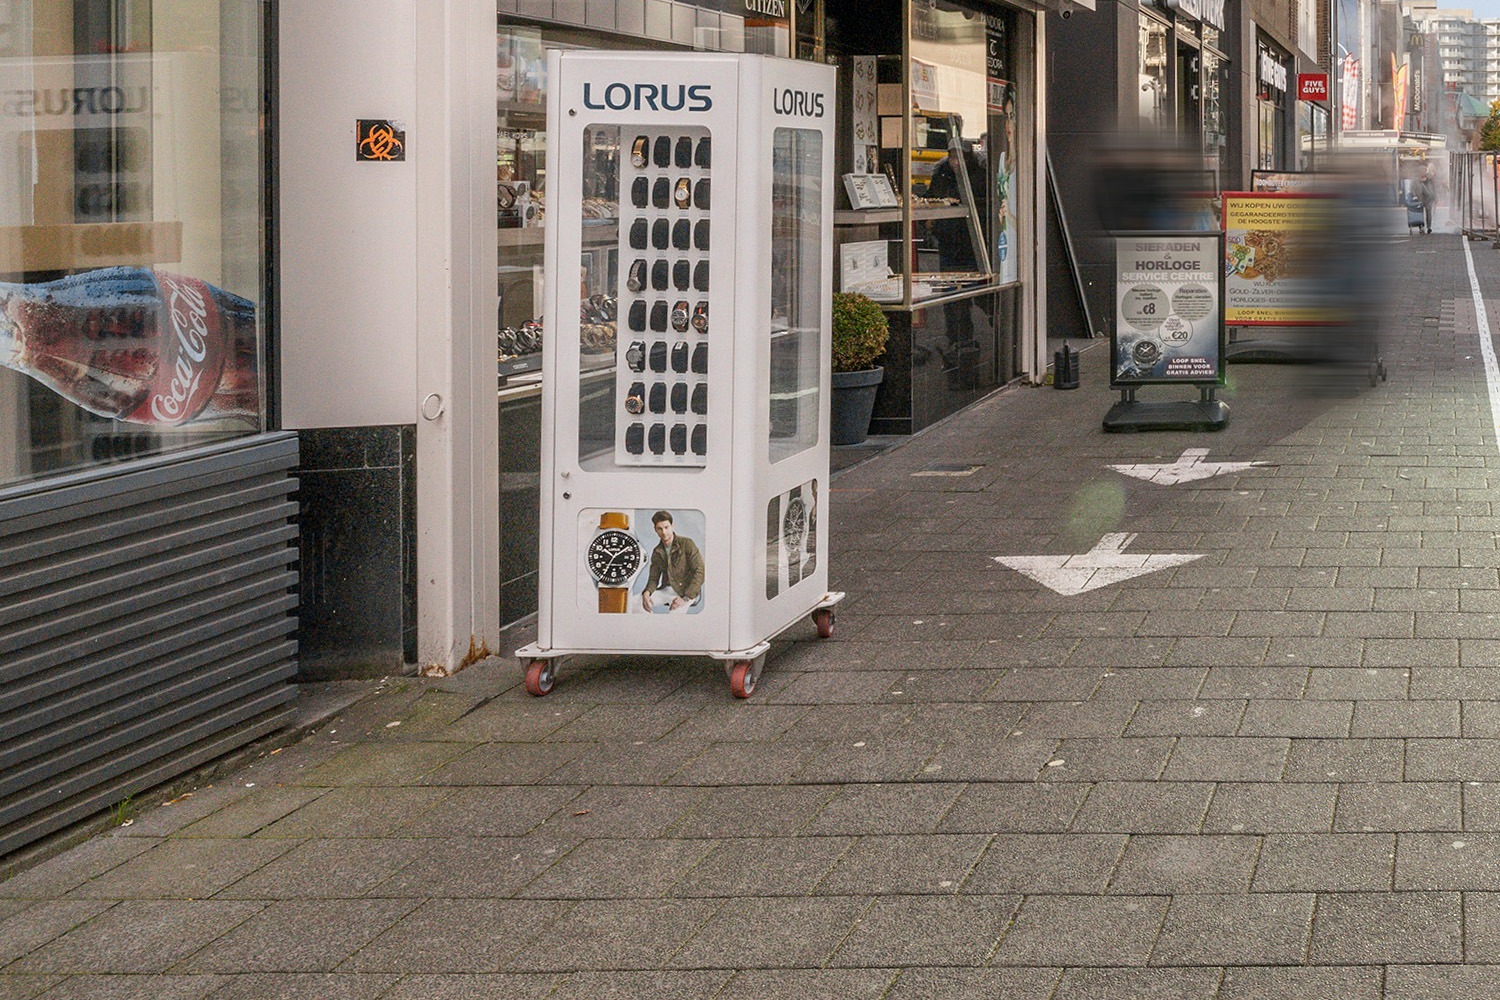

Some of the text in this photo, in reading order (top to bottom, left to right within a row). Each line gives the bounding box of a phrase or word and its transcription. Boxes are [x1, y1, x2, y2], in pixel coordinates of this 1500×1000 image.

[1304, 80, 1323, 88] FIVE
[583, 82, 713, 112] LORUS
[773, 87, 825, 118] LORUS
[1135, 242, 1201, 252] SIERADEN
[1163, 252, 1172, 260] &
[1135, 260, 1201, 270] HORLOGE
[1121, 272, 1215, 281] SERVICE CENTRE
[1143, 302, 1156, 315] €8
[1171, 331, 1188, 340] €20
[151, 280, 208, 423] Coca-Cola
